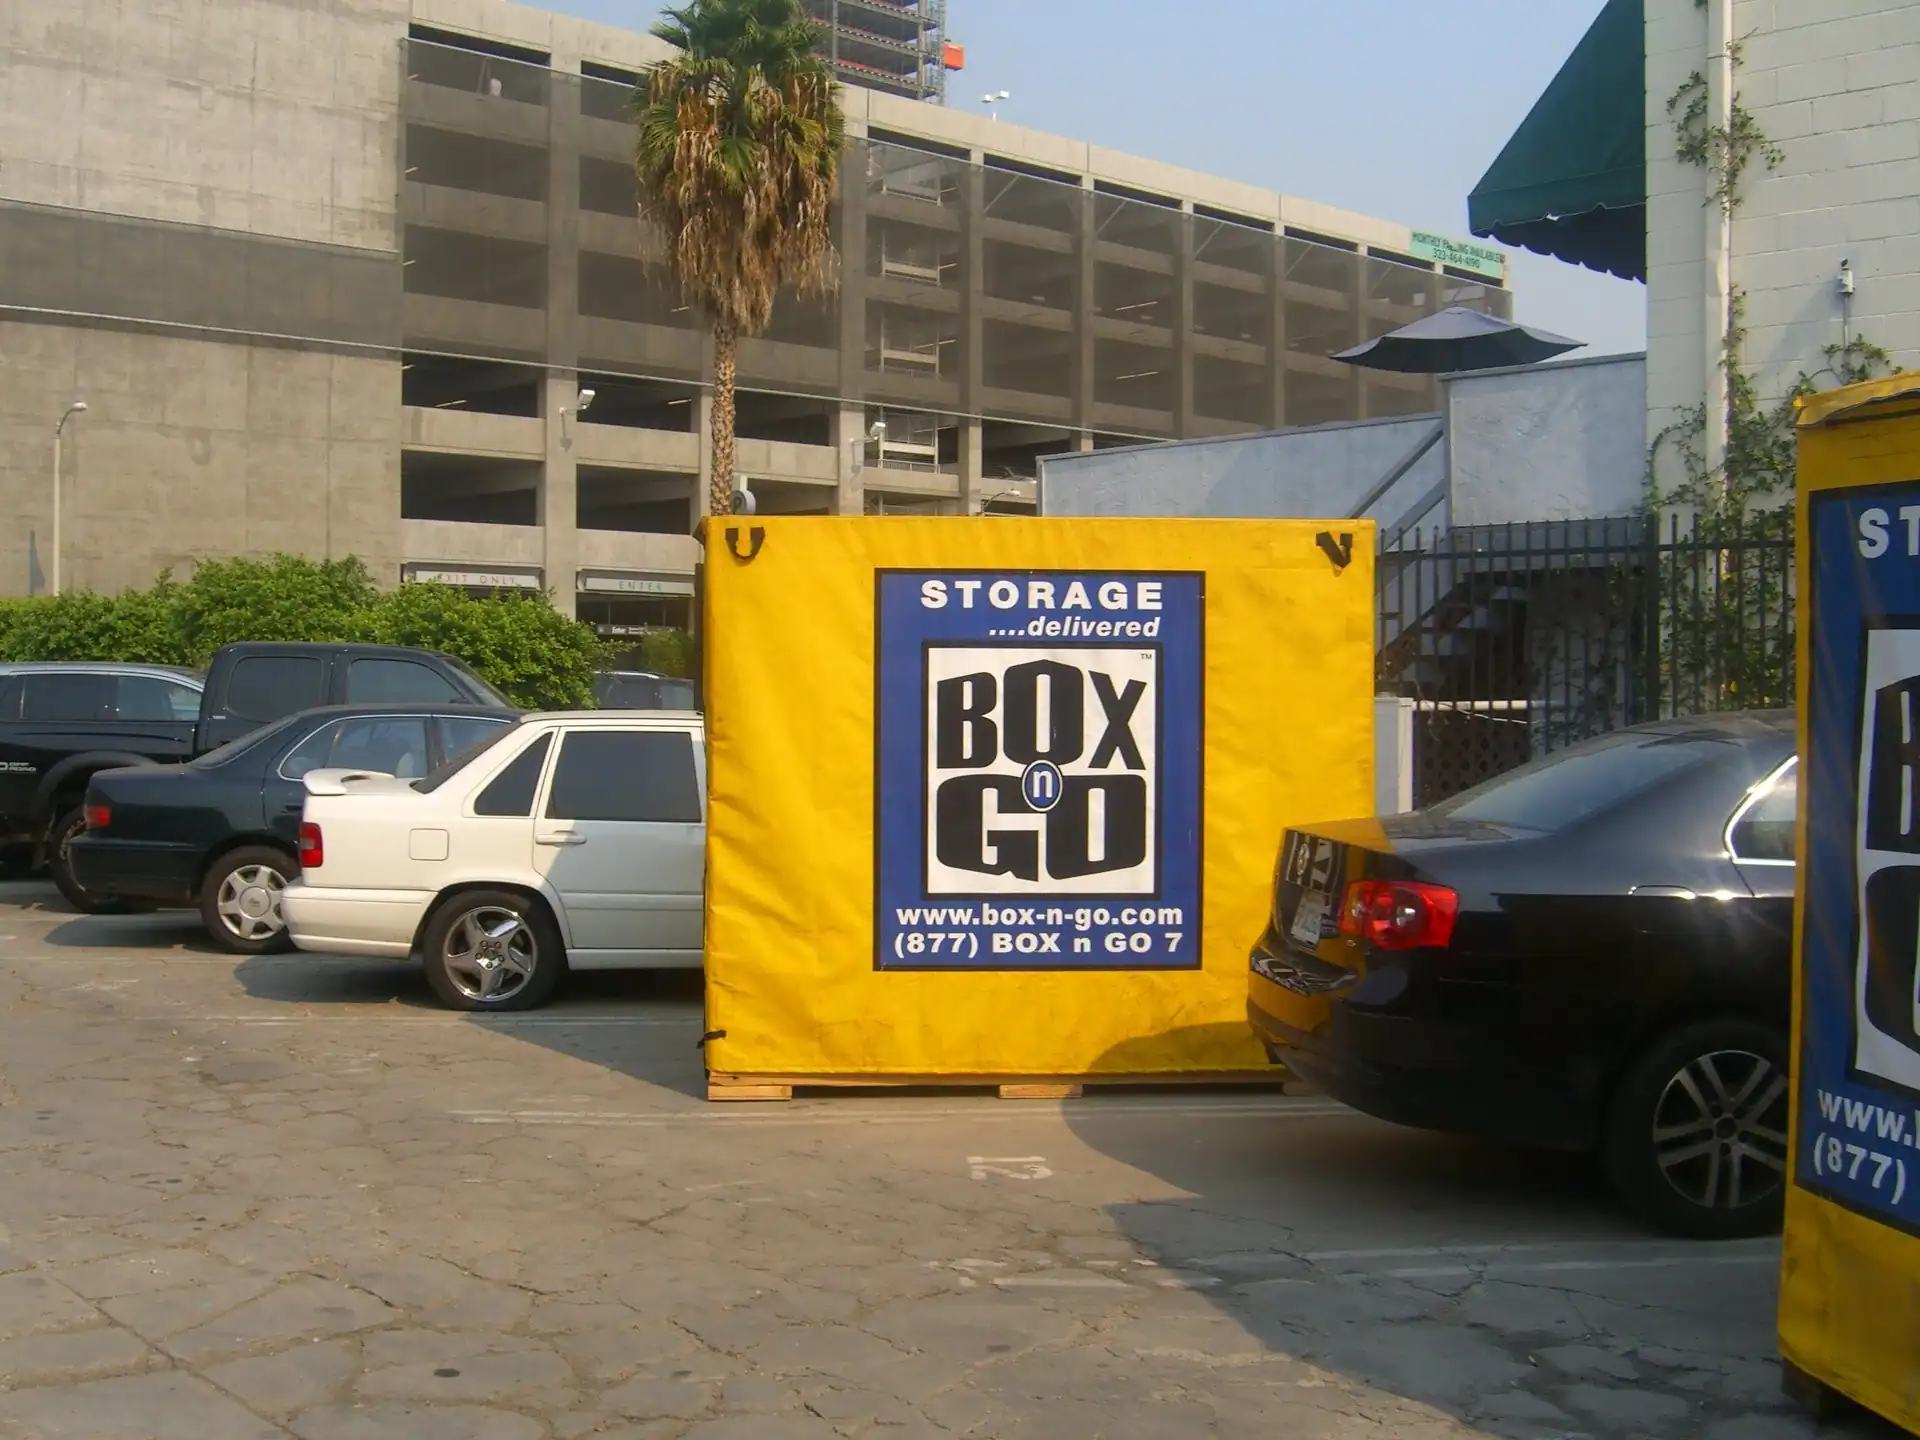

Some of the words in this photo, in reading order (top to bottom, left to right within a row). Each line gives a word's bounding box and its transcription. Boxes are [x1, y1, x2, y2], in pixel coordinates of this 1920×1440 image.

[479, 575, 516, 585] ONLY
[920, 579, 1163, 610] STORAGE
[936, 659, 1148, 770] BOX
[936, 773, 1147, 883] GO
[896, 903, 1183, 931] www.box-n-go.com
[894, 932, 979, 959] (877)
[992, 932, 1062, 954] BOX
[1073, 937, 1092, 954] n
[1104, 932, 1153, 954] GO
[1164, 932, 1184, 954] 7
[1817, 1089, 1920, 1150] www.
[1813, 1132, 1906, 1205] (877)
